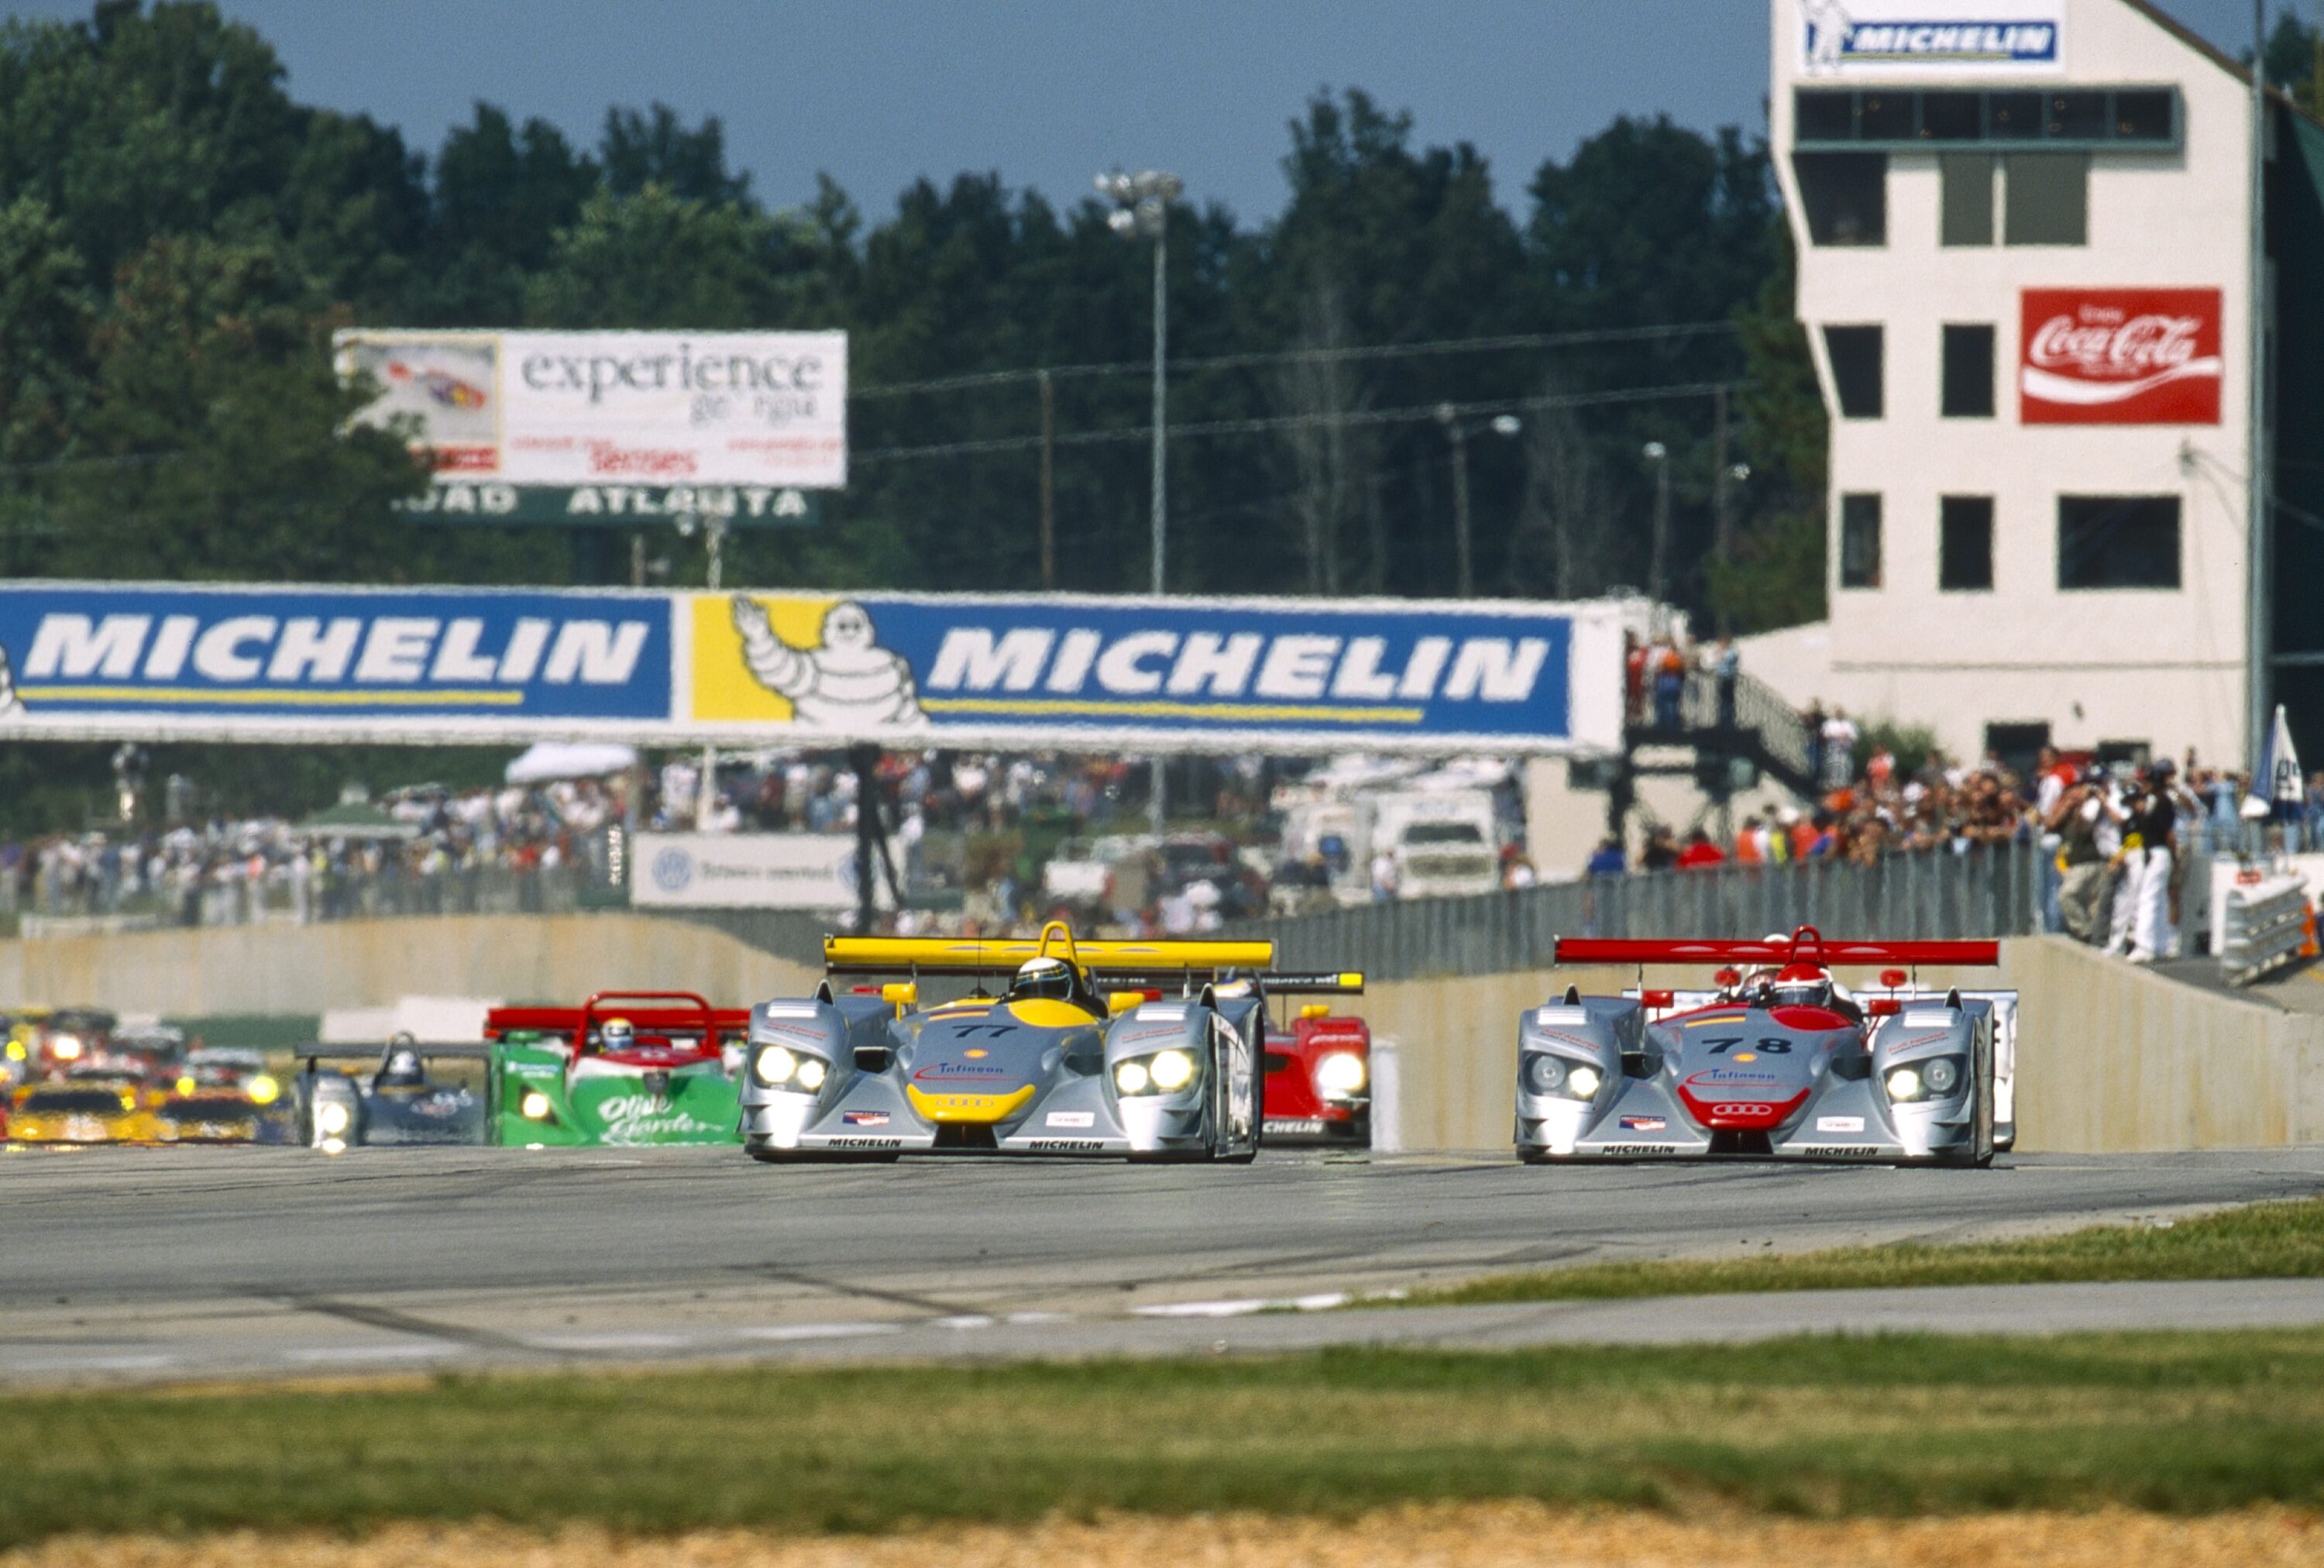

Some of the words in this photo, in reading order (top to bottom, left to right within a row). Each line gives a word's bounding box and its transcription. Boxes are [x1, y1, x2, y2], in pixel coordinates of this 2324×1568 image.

[1852, 25, 2052, 52] MICHELIN
[521, 343, 821, 404] experience
[22, 612, 650, 685] MICHELIN
[927, 626, 1550, 703] MICHELIN
[951, 1024, 1018, 1038] 77
[1701, 1037, 1793, 1054] 78
[940, 1062, 1004, 1074] Infineon
[1710, 1068, 1776, 1080] Infineon
[596, 1094, 672, 1122] Olive
[600, 1112, 725, 1146] Garden
[1262, 1121, 1323, 1134] CHELIN
[828, 1138, 902, 1147] MICHELIN
[1029, 1140, 1104, 1150] MICHELIN
[1602, 1145, 1676, 1154] MICHELIN
[1804, 1147, 1879, 1157] MICHELIN
